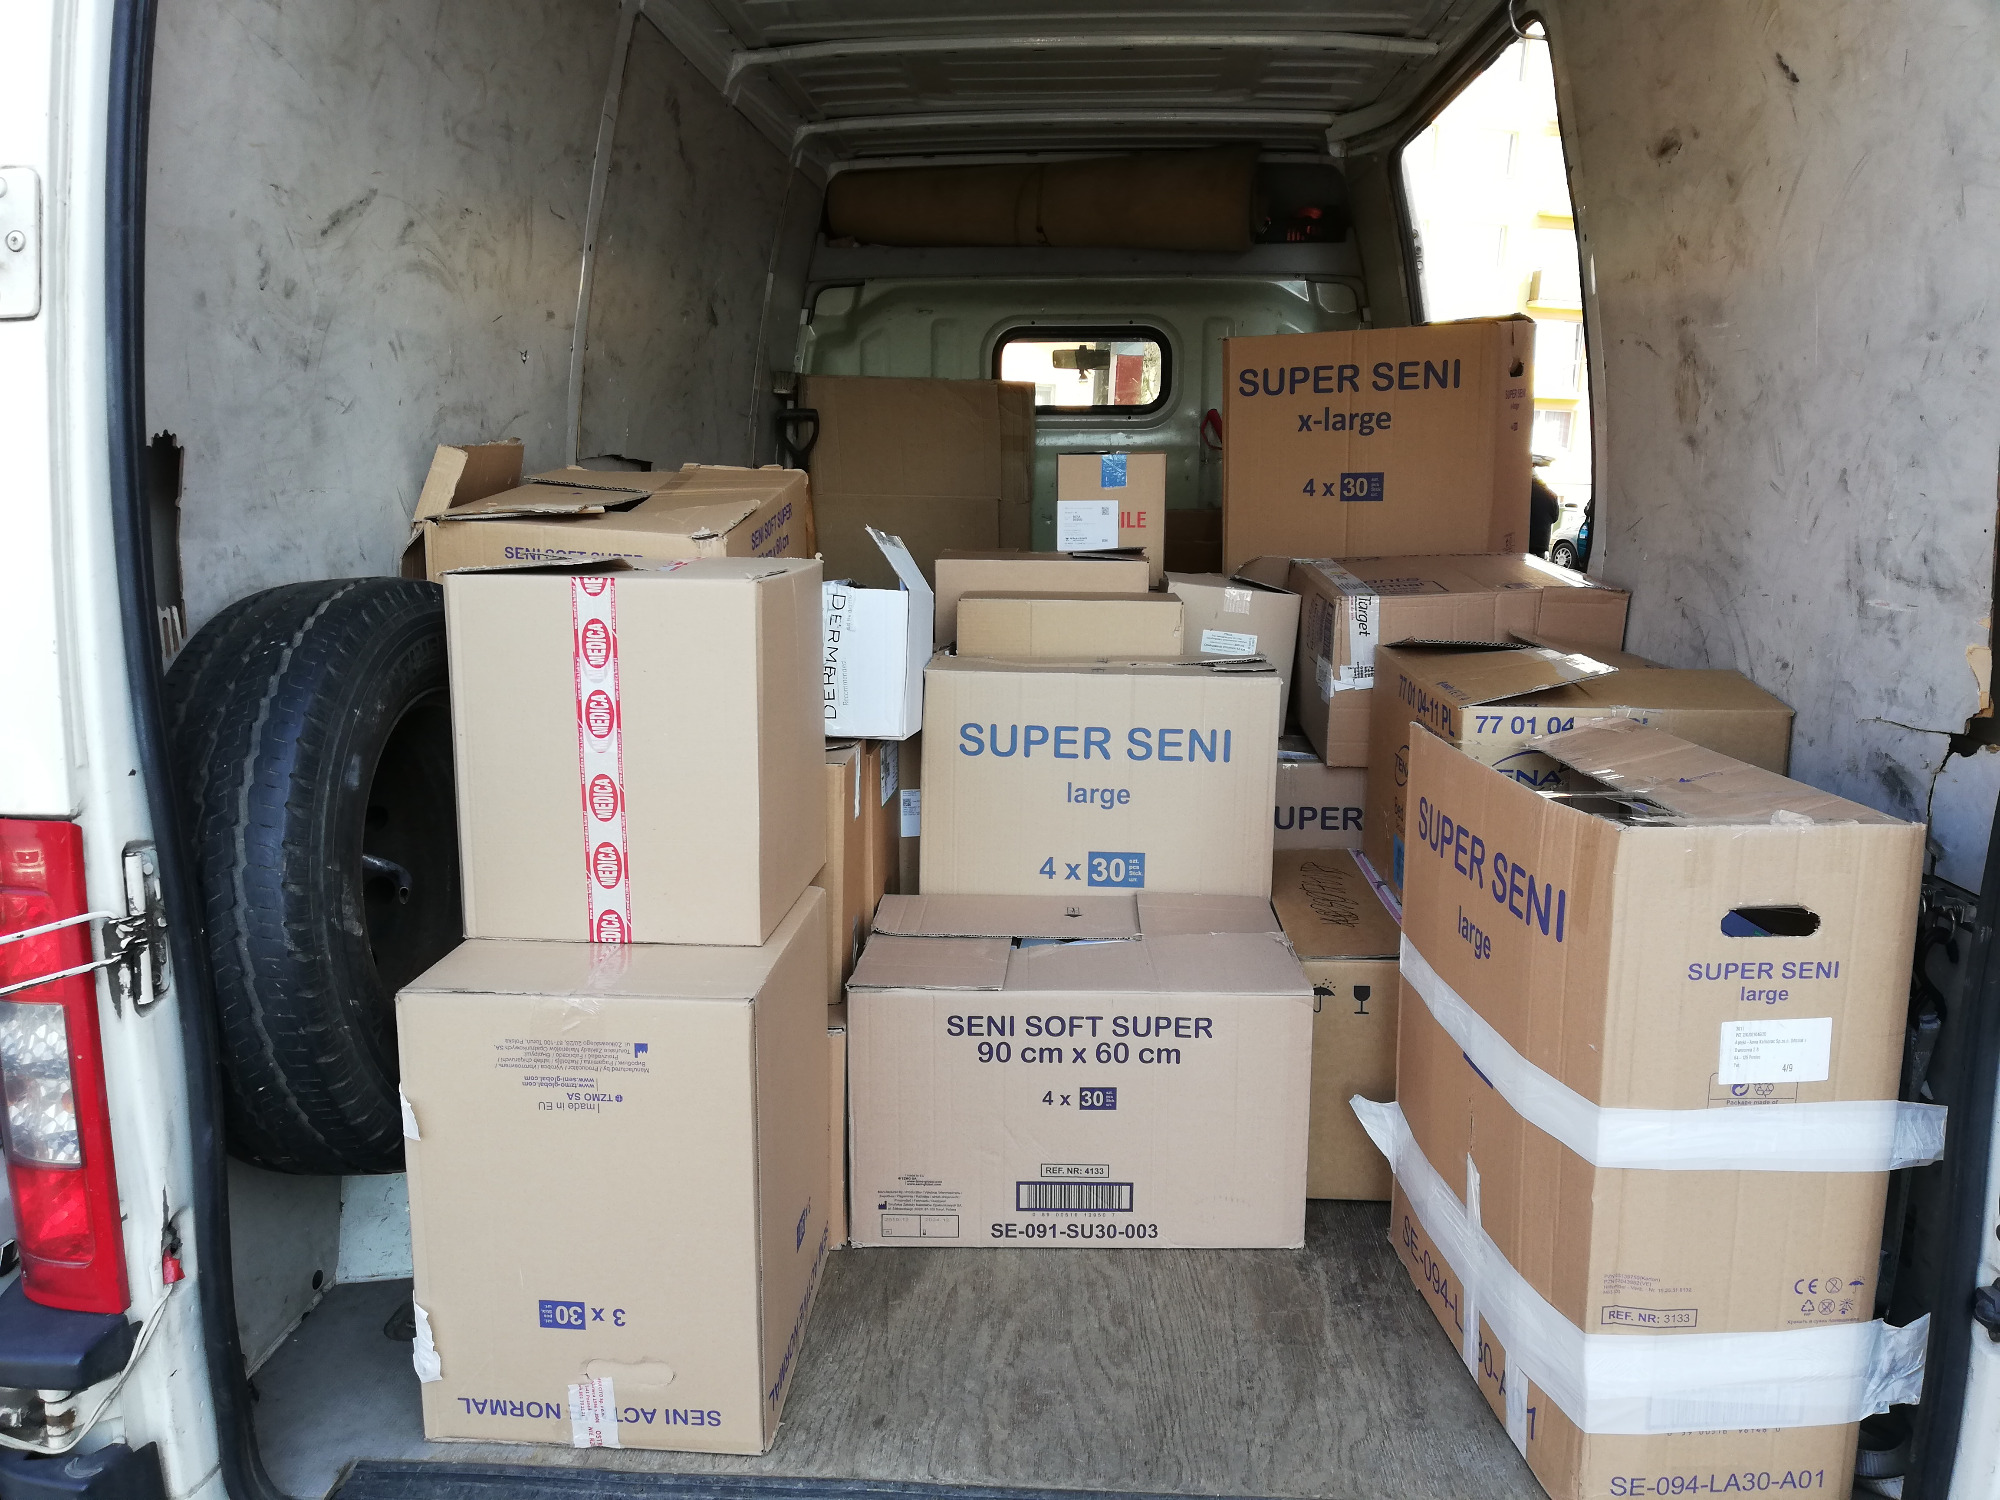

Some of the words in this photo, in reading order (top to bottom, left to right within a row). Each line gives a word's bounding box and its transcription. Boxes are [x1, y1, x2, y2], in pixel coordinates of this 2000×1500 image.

[1239, 366, 1360, 397] SUPER
[1371, 359, 1462, 392] SENI
[1297, 404, 1392, 436] x-large
[1302, 478, 1316, 498] 4
[1321, 483, 1335, 498] x
[1342, 476, 1368, 498] 30
[504, 546, 542, 561] SENI
[1356, 596, 1372, 637] Target
[586, 624, 606, 665] MEDICA
[589, 694, 610, 735] MEDICA
[1398, 674, 1407, 700] 77
[1407, 684, 1415, 707] 01
[1441, 704, 1455, 737] PL
[1476, 715, 1504, 734] 77
[1511, 716, 1537, 735] 01
[957, 722, 1112, 761] SUPER
[1126, 727, 1232, 764] SENI
[593, 778, 615, 818] MEDICA
[1067, 781, 1131, 810] large
[1275, 806, 1364, 831] UPER
[597, 847, 618, 886] MEDICA
[1038, 856, 1056, 880] 4
[1065, 862, 1081, 881] x
[1092, 857, 1126, 882] 30
[1418, 797, 1486, 890] SUPER
[1490, 851, 1567, 944] SENI
[600, 913, 621, 944] EDICA
[1456, 904, 1492, 961] large
[1687, 961, 1775, 981] SUPER
[1781, 960, 1840, 980] SENI
[1740, 984, 1790, 1005] large
[946, 1014, 1016, 1038] SENI
[1024, 1015, 1104, 1039] SOFT
[1111, 1016, 1214, 1040] SUPER
[976, 1041, 1013, 1065] 90
[1020, 1046, 1064, 1064] cm
[1071, 1047, 1087, 1064] x
[1095, 1041, 1131, 1065] 60
[1138, 1046, 1181, 1065] cm
[1781, 1063, 1793, 1072] 4/9
[538, 1101, 553, 1111] EU
[556, 1101, 565, 1111] in
[567, 1092, 581, 1101] SA
[567, 1102, 596, 1112] made
[584, 1092, 613, 1102] TZMO
[1042, 1090, 1055, 1107] 4
[1059, 1094, 1071, 1107] x
[1081, 1089, 1104, 1108] 30
[1045, 1166, 1065, 1175] REF.
[1066, 1167, 1083, 1175] NR:
[1084, 1167, 1105, 1175] 4133
[990, 1223, 1159, 1240] SE-091-SU30-003
[555, 1305, 583, 1326] 30
[590, 1307, 604, 1322] x
[612, 1308, 627, 1327] 3
[1608, 1310, 1634, 1322] REF.
[1638, 1312, 1660, 1324] NR:
[1663, 1313, 1690, 1324] 3133
[457, 1397, 561, 1420] NORMAL
[615, 1406, 657, 1426] ACT
[665, 1408, 722, 1427] SENI
[1609, 1468, 1826, 1498] SE-094-LA30-A01
